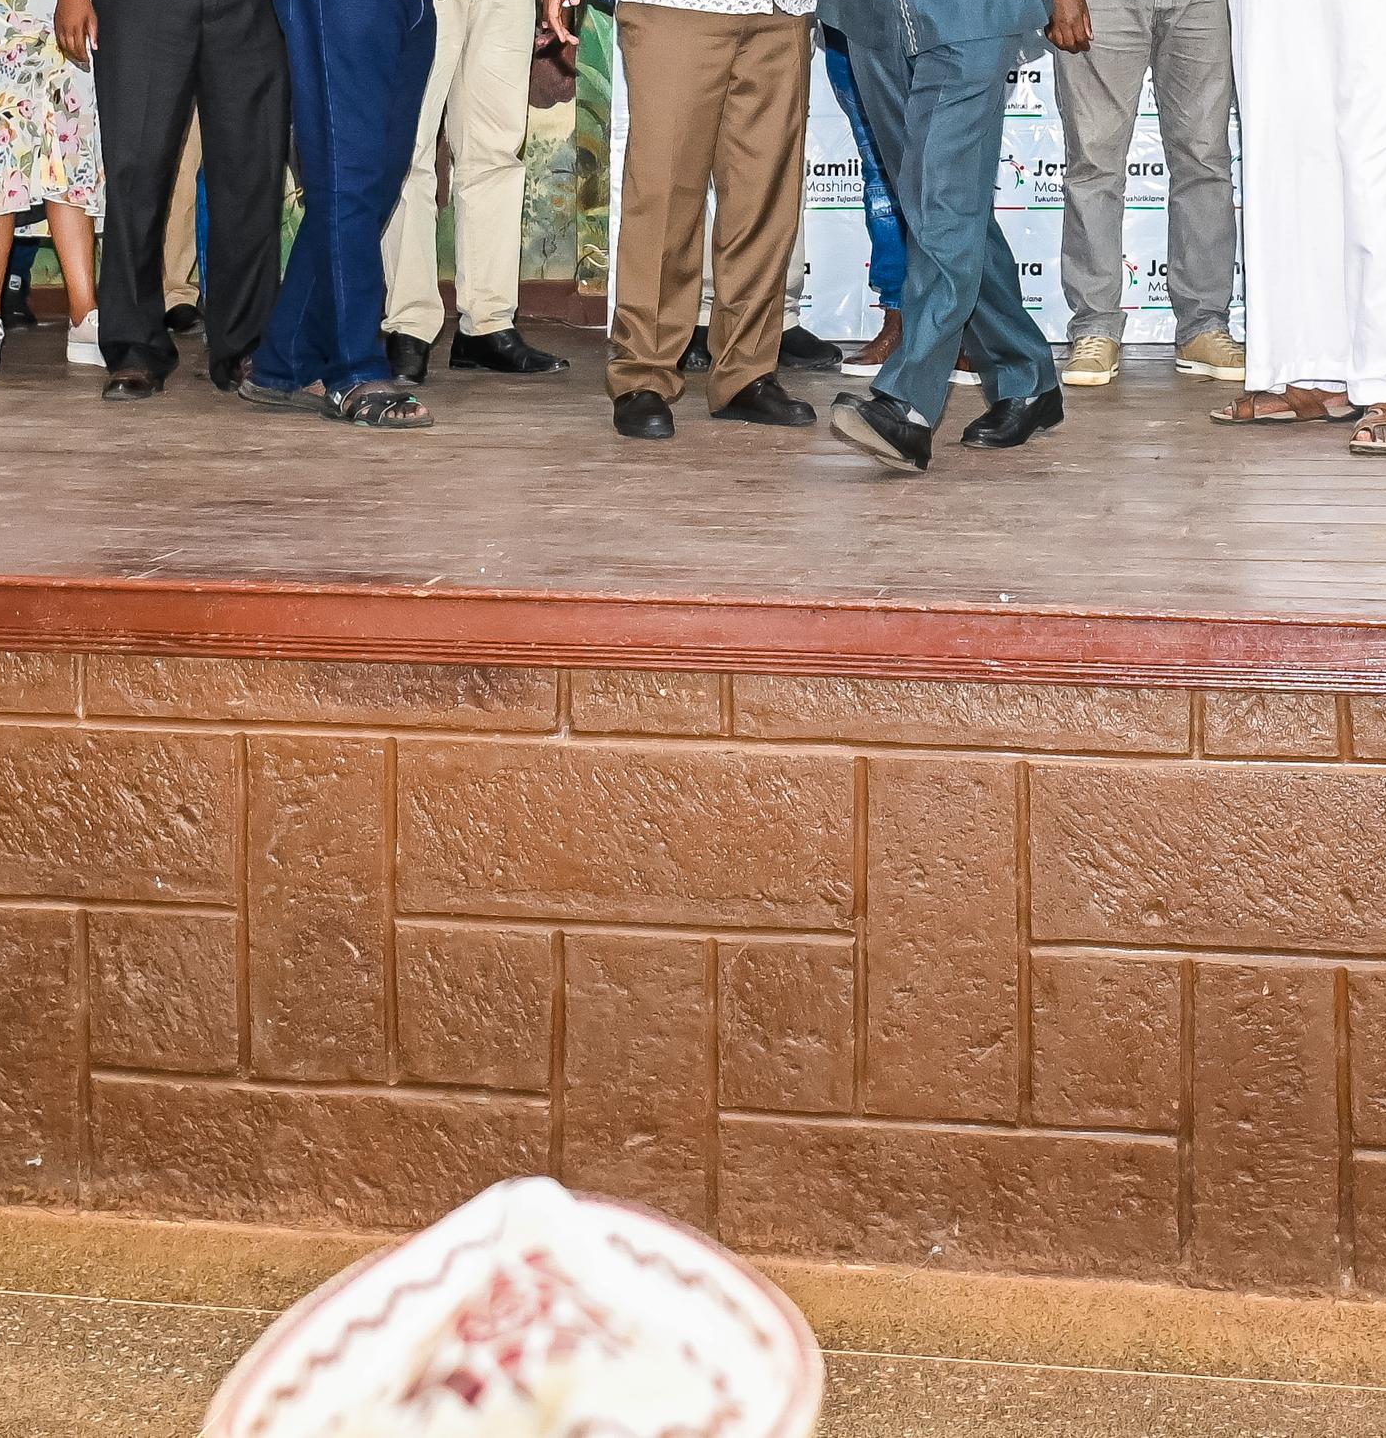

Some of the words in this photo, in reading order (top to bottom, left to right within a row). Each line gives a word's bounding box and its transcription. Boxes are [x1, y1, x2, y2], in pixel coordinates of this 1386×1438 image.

[1006, 70, 1041, 83] ara
[1128, 163, 1164, 176] ara
[807, 180, 862, 192] Mashina
